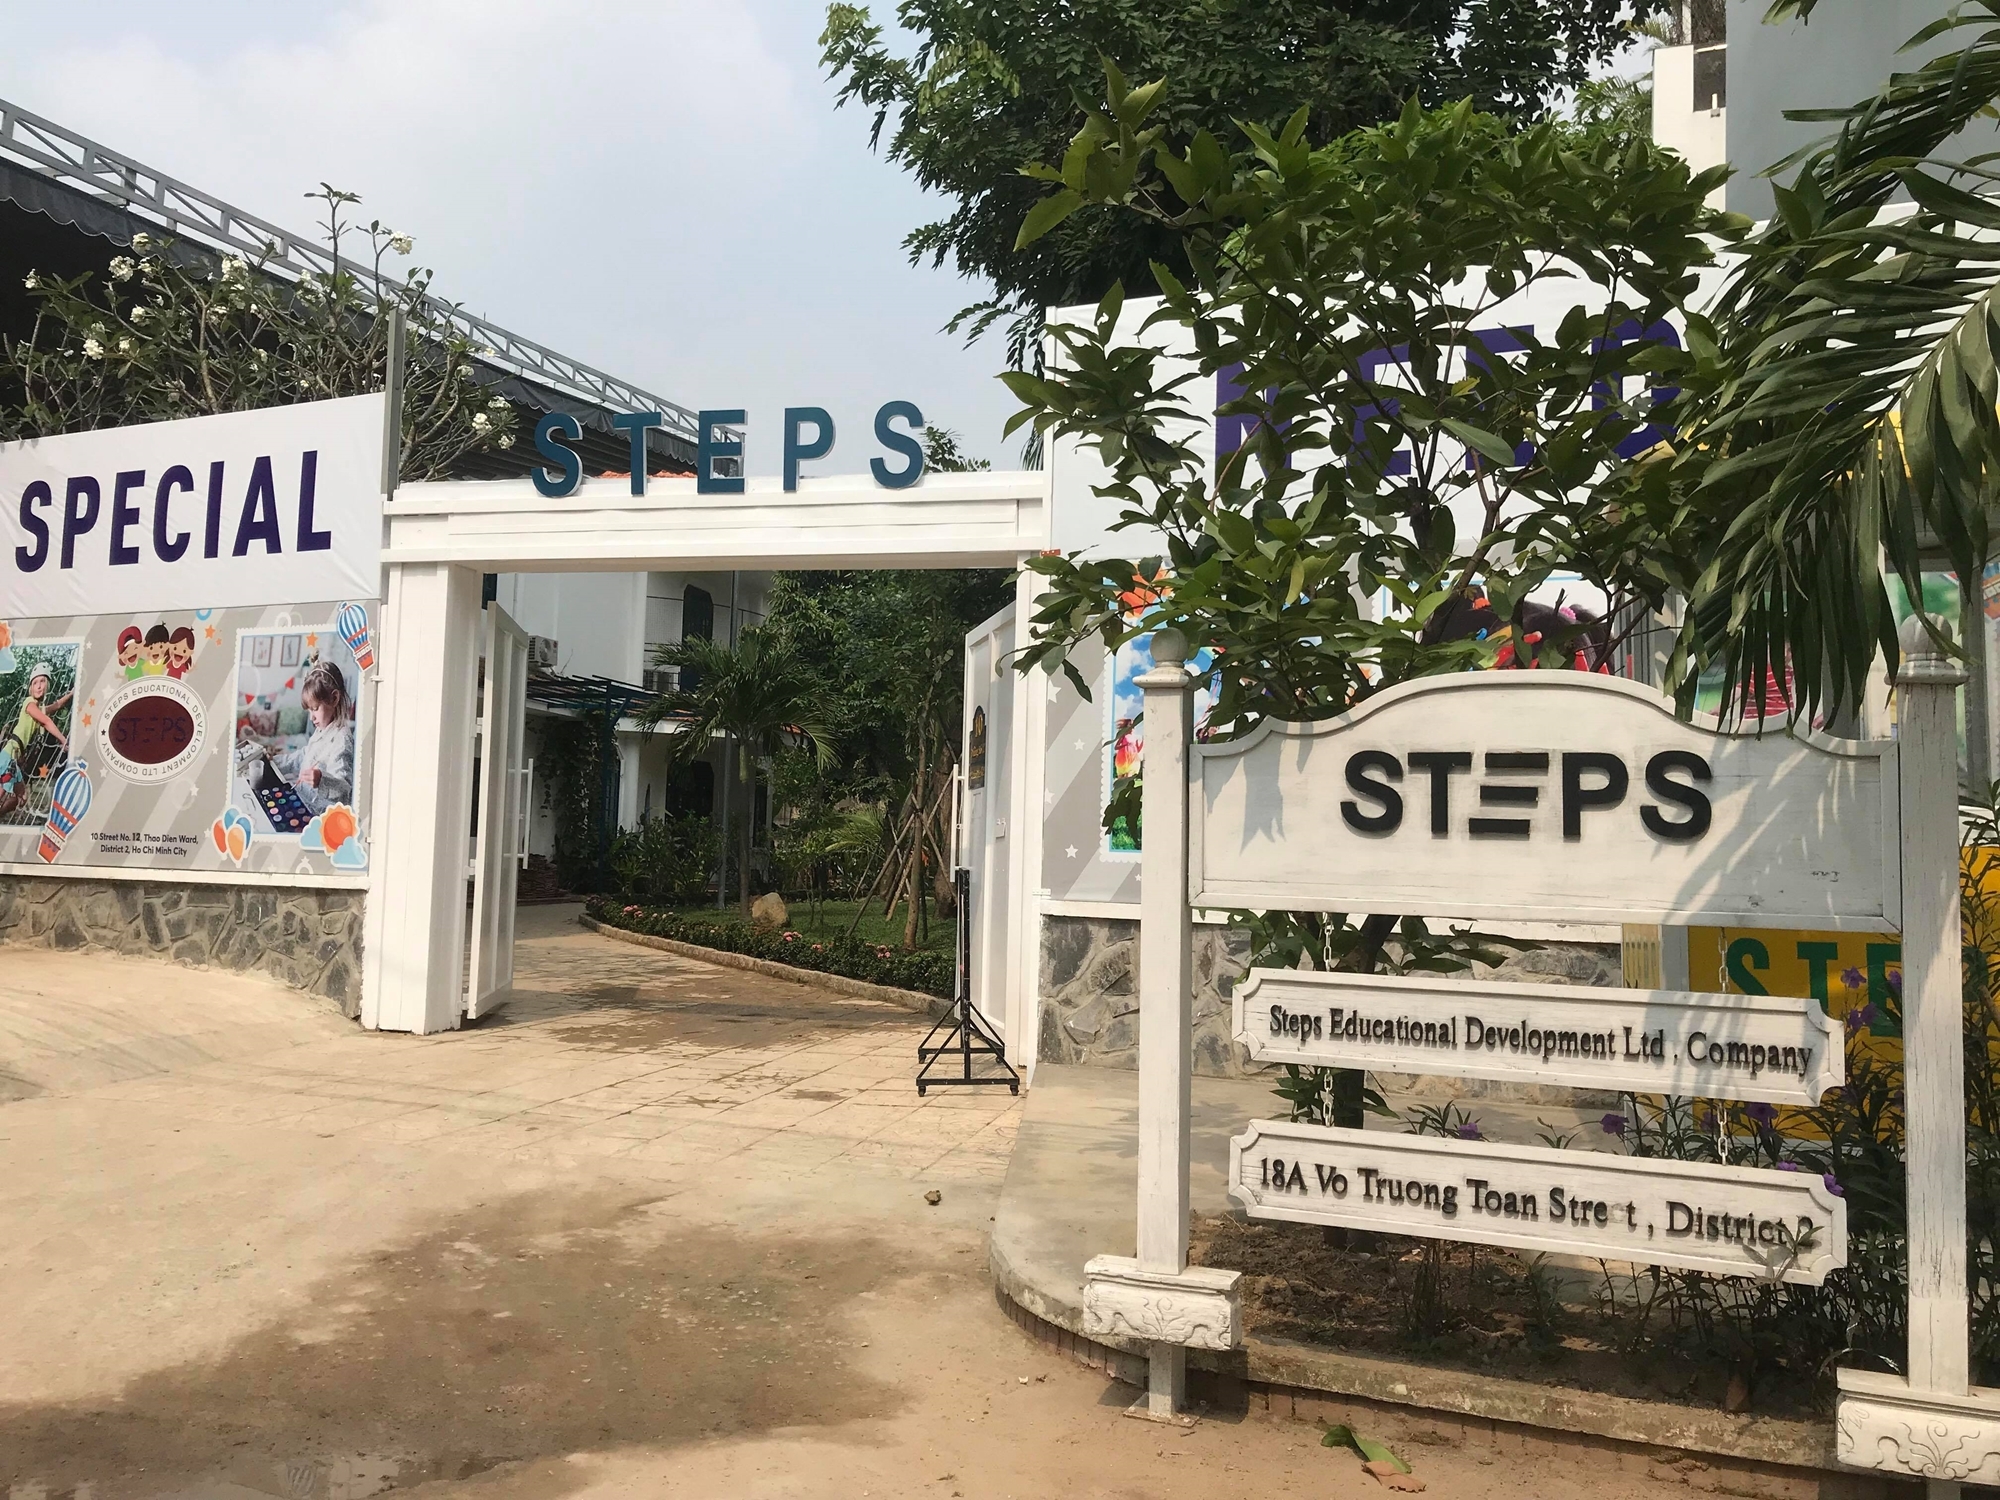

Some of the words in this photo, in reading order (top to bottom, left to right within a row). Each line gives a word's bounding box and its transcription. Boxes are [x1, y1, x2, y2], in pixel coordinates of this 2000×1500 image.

[530, 400, 926, 498] STEPS
[15, 449, 332, 573] SPECIAL
[104, 693, 129, 720] STEPS
[131, 684, 190, 705] EDUCATIONAL
[115, 716, 187, 743] STEPS
[161, 704, 203, 774] DEVELOPMENT
[102, 742, 138, 774] COMPANY
[142, 768, 158, 776] LTD
[1340, 750, 1713, 841] STEPS
[91, 832, 98, 841] 10
[100, 832, 119, 841] Street
[120, 833, 131, 842] No.
[143, 833, 161, 842] Thao
[162, 834, 177, 843] Dien
[178, 834, 199, 844] Ward,
[100, 844, 124, 854] District
[131, 845, 141, 854] Ho
[142, 845, 154, 854] Chi
[155, 846, 172, 855] Minh
[173, 846, 188, 857] City
[1270, 1004, 1323, 1041] Steps
[1329, 1008, 1457, 1044] Educational
[1464, 1016, 1616, 1060] Development
[1687, 1031, 1814, 1077] Company
[1261, 1157, 1308, 1191] 18A
[1315, 1163, 1349, 1195] Vo
[1357, 1168, 1458, 1213] Truong
[1466, 1178, 1539, 1216] Toan
[1549, 1186, 1638, 1228] Stret
[1666, 1200, 1788, 1245] District
